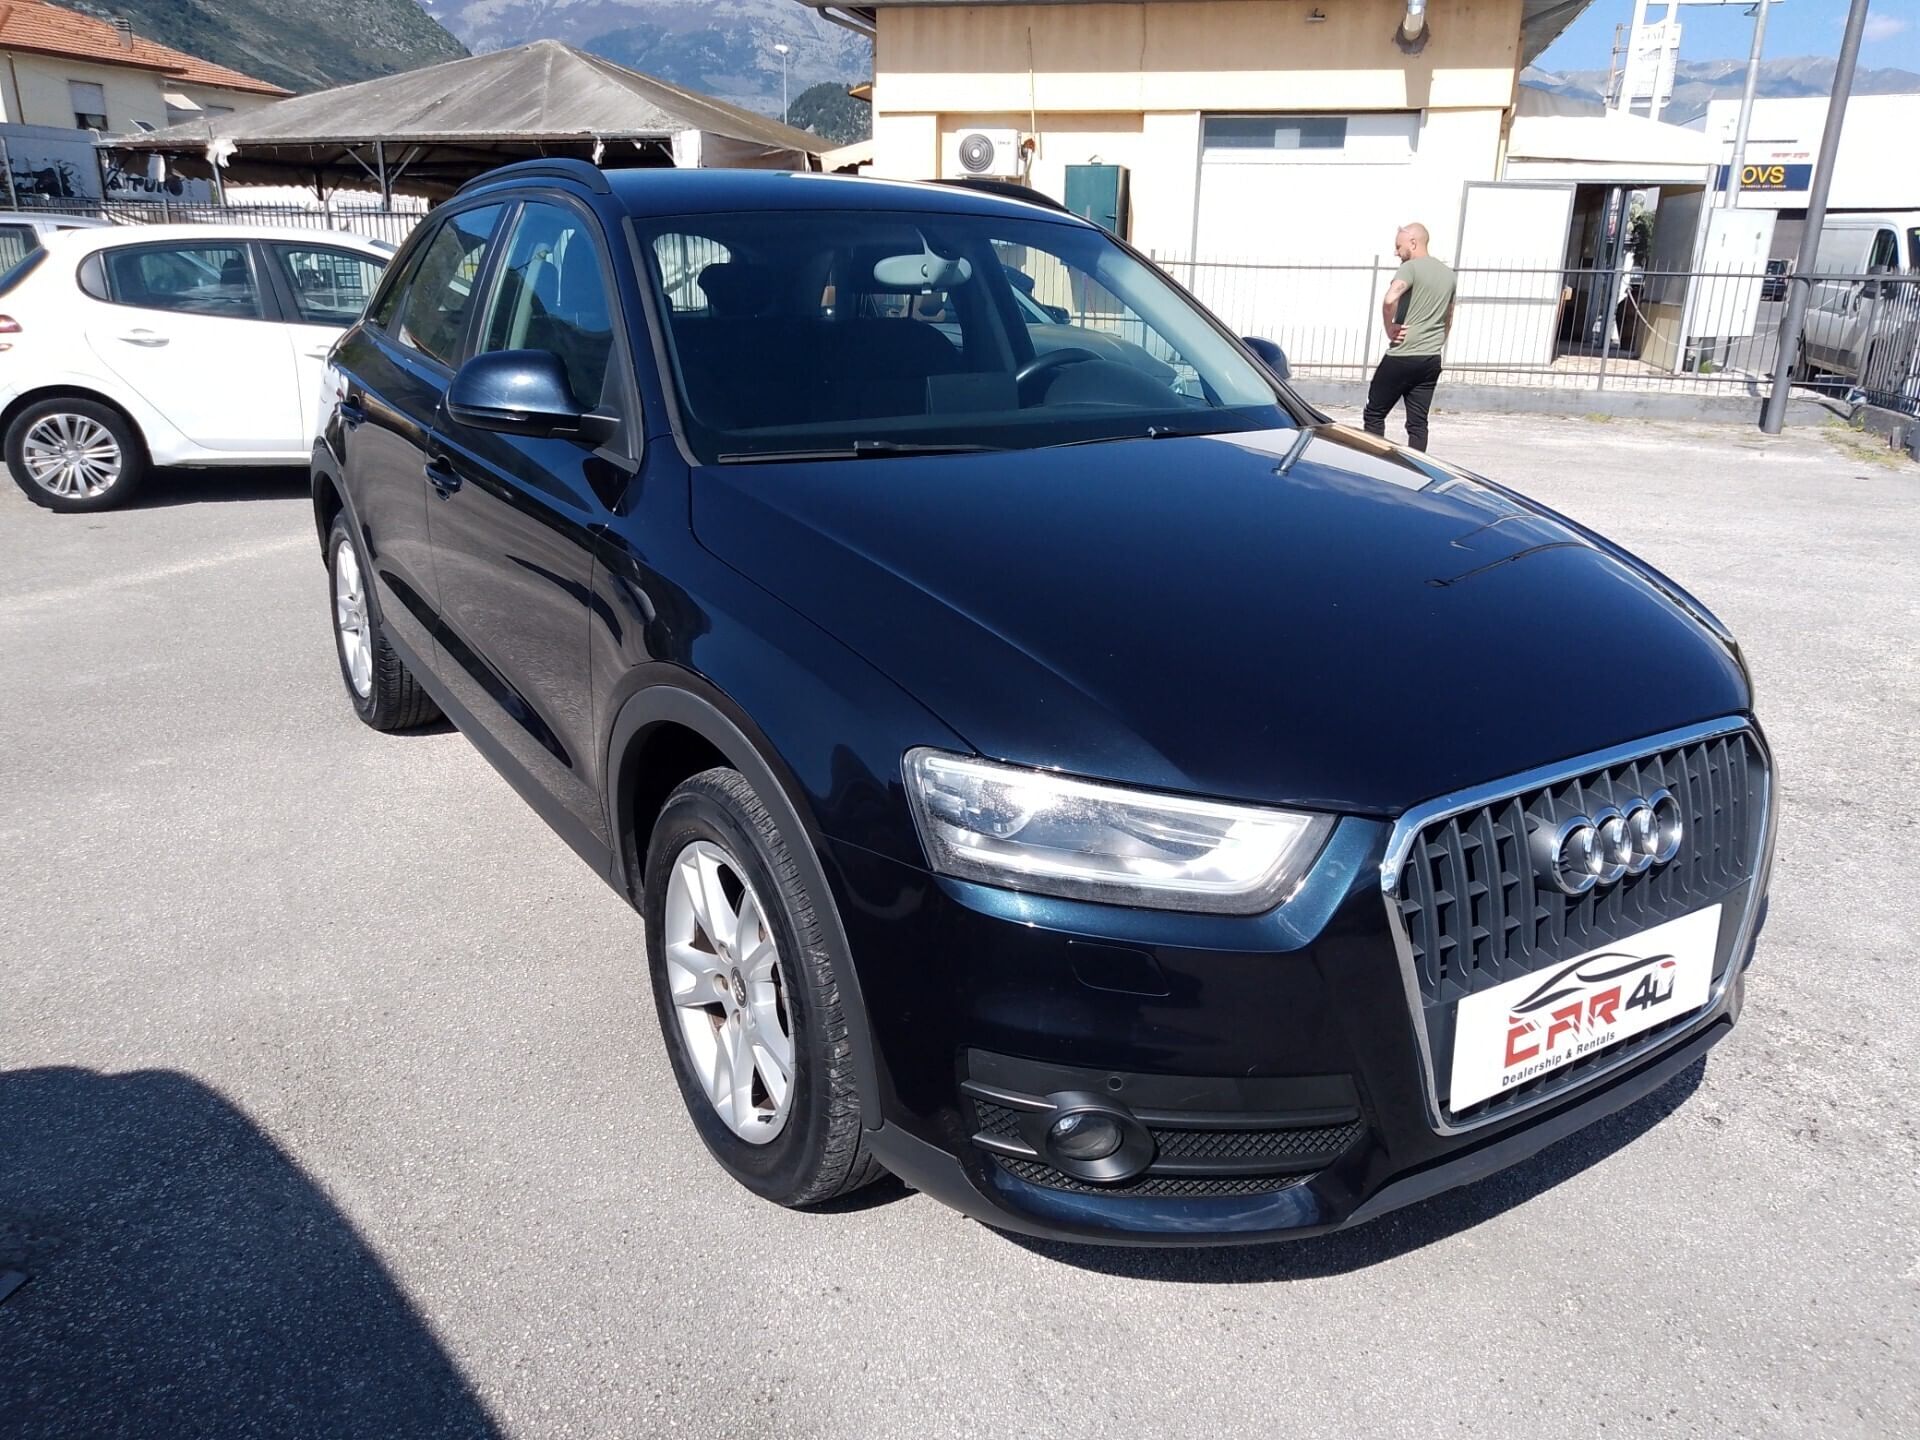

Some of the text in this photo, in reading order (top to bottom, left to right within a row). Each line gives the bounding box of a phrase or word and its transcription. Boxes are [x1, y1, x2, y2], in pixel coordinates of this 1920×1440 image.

[1741, 166, 1785, 184] OVS
[1502, 1031, 1616, 1087] Dealership & Rentals
